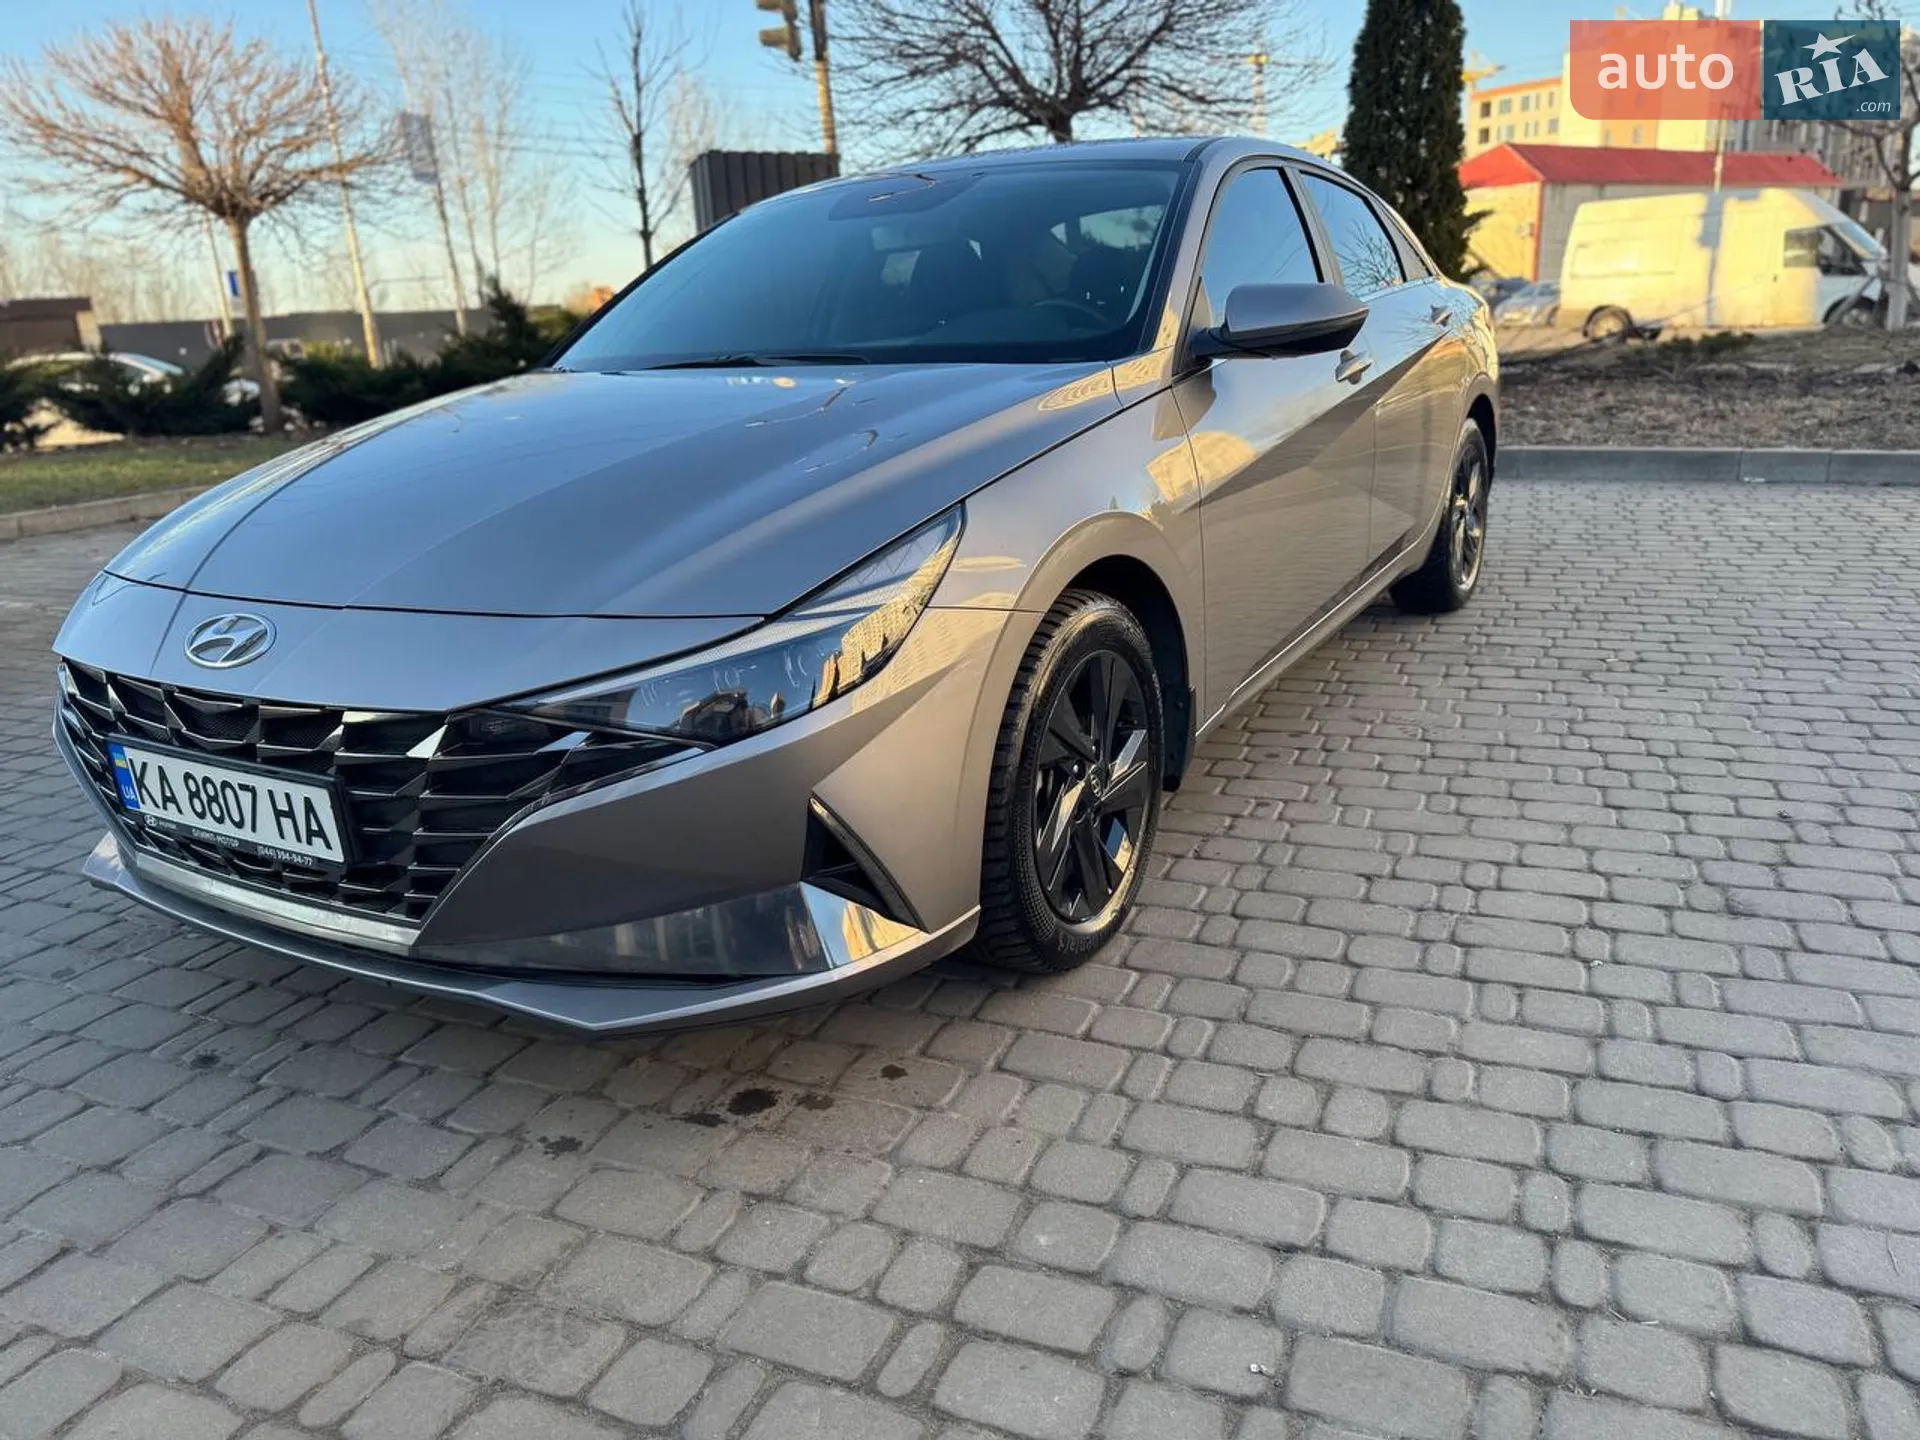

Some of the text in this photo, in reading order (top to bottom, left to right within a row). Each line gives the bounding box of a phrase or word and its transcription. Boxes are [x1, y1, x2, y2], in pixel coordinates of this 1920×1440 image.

[129, 758, 333, 850] KA 8807 HA
